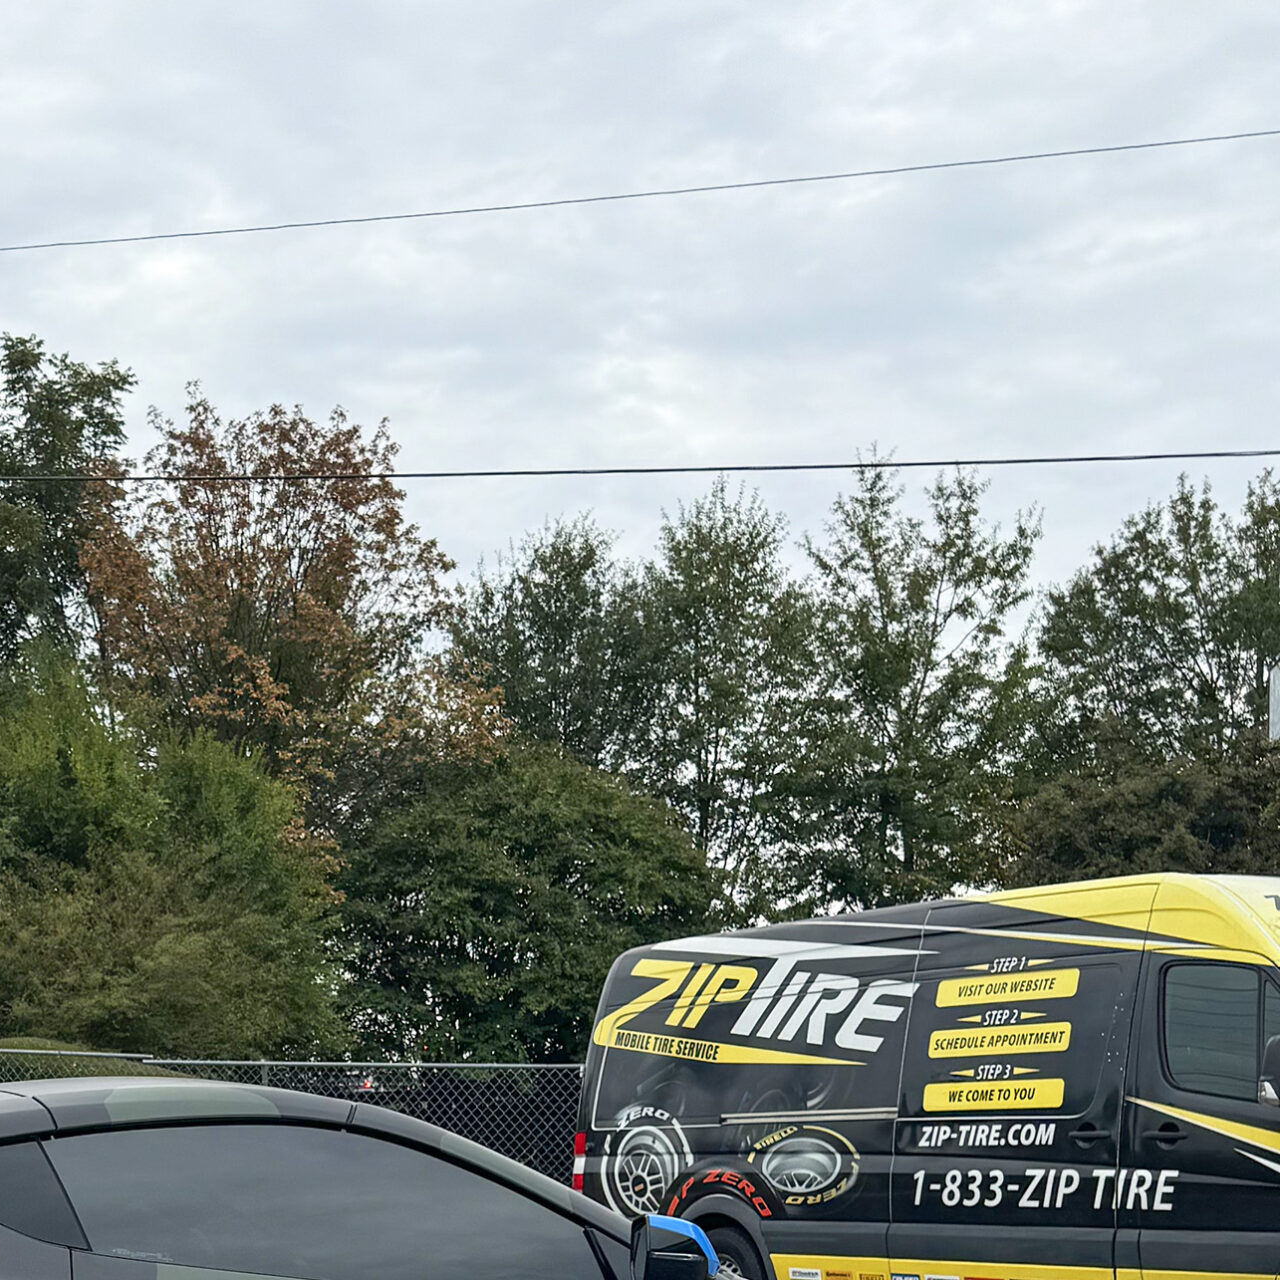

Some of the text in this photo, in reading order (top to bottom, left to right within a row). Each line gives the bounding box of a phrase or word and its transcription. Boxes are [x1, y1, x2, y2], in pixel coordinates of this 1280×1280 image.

[990, 957, 1026, 973] STEP 1
[958, 977, 1056, 998] VISIT OUR WEBSITE
[983, 1009, 1019, 1025] STEP 2
[615, 1031, 720, 1060] MOBILE TIRE SERVICE
[934, 1031, 1065, 1051] SCHEDULE APPOINTMENT
[976, 1064, 1011, 1080] STEP 3
[949, 1088, 1035, 1103] WE COME TO YOU
[616, 1106, 670, 1132] ZERO
[918, 1123, 1056, 1147] ZIP-TIRE.COM
[702, 1169, 772, 1218] ZERO
[785, 1177, 847, 1205] ZERO
[913, 1169, 1180, 1211] 1-833-ZIP TIRE
